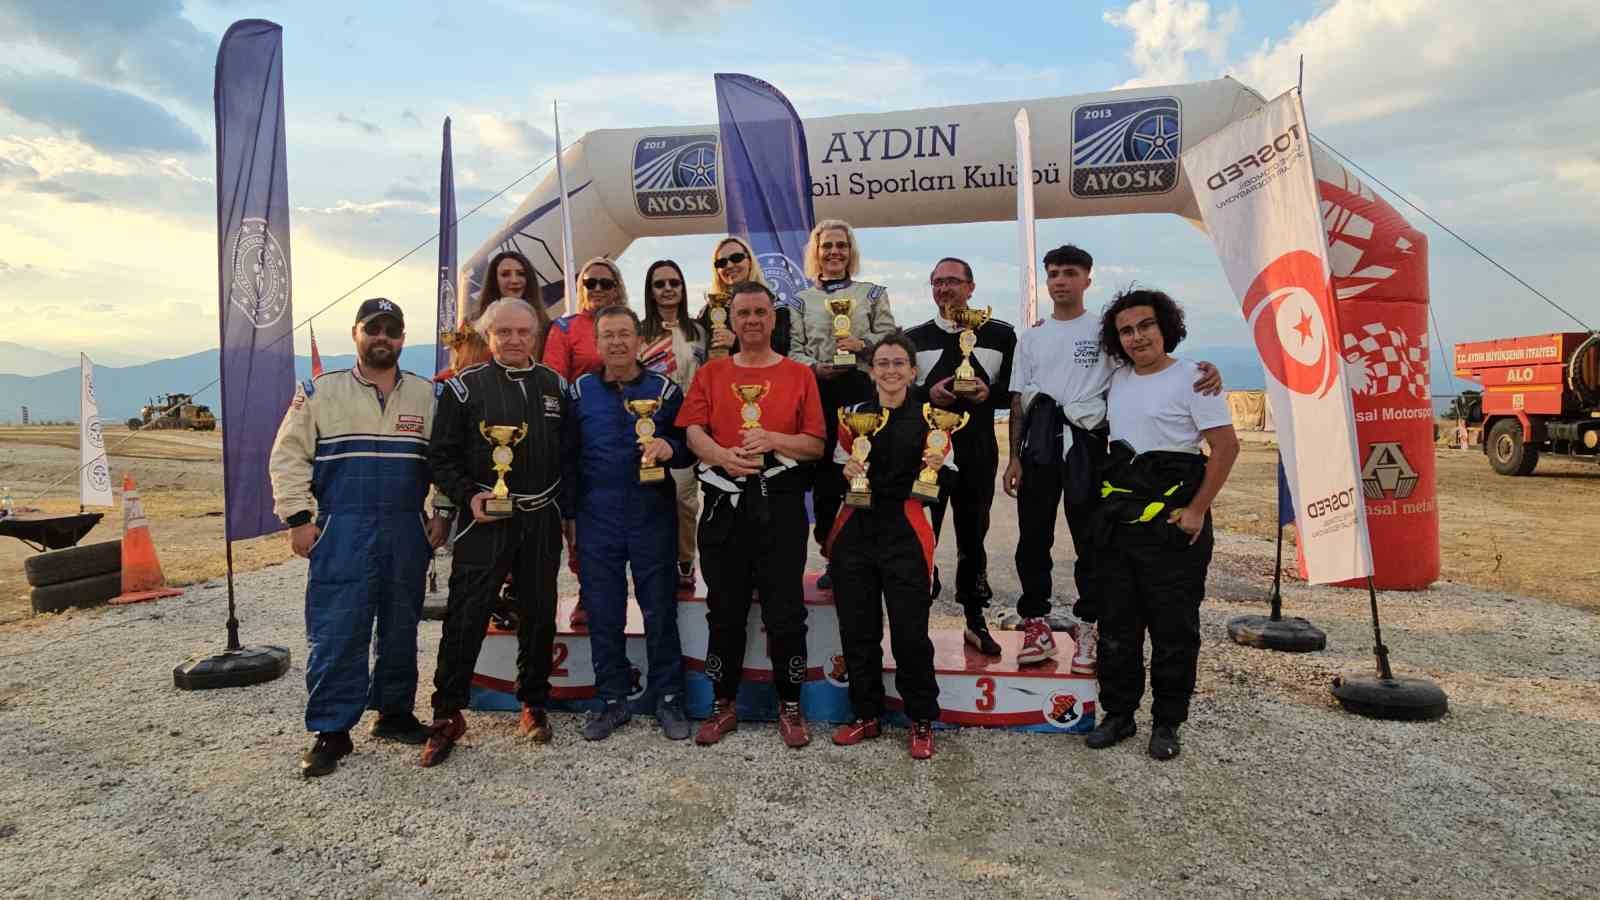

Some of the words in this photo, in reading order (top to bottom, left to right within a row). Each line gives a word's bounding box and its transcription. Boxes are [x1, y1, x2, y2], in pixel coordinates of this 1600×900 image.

[1083, 109, 1112, 119] 2013
[643, 141, 666, 150] 2013
[821, 124, 960, 164] AYDIN
[1084, 169, 1165, 192] AYOSK
[648, 195, 712, 213] AYOSK
[1507, 367, 1534, 383] ALO
[1356, 409, 1378, 422] sal
[551, 642, 569, 677] 2
[976, 677, 996, 712] 3
